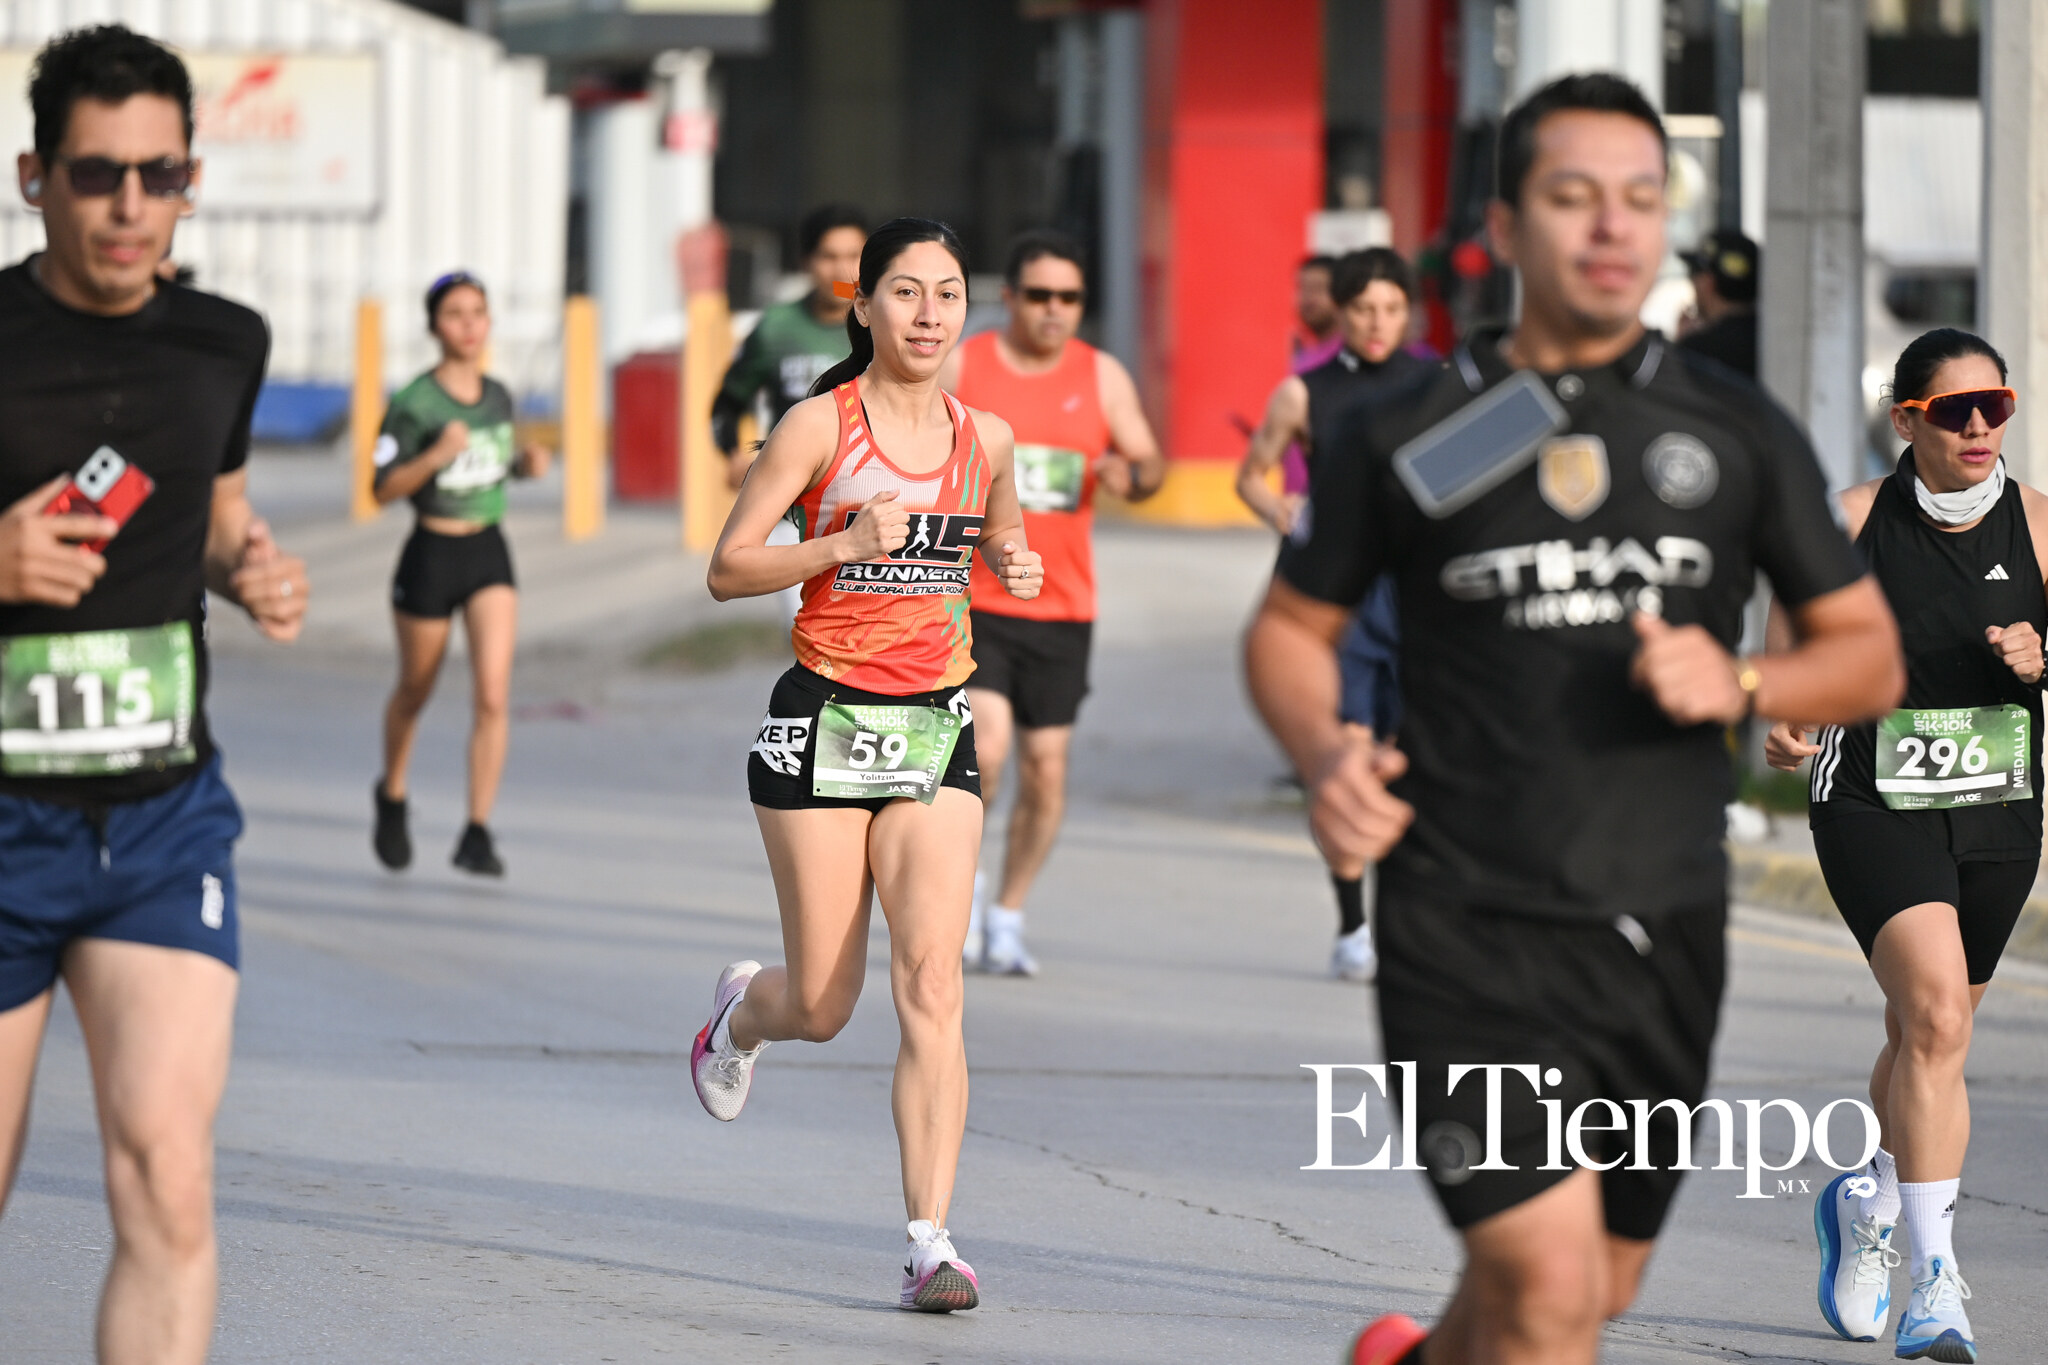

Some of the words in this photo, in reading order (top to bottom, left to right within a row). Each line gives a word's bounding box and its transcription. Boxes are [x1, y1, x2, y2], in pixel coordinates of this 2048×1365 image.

[840, 564, 969, 584] RUNNERS
[832, 582, 866, 592] CLUB
[866, 585, 904, 594] NORA
[905, 586, 944, 594] LETICIA
[27, 667, 154, 731] 115
[854, 708, 909, 716] CARRERA
[943, 717, 955, 727] 59
[1913, 711, 1973, 720] CARRERA
[2011, 709, 2028, 719] 296
[848, 731, 909, 770] 59
[1895, 735, 1989, 778] 296
[2013, 724, 2026, 788] MEDALLA
[923, 733, 951, 792] MEDALLA
